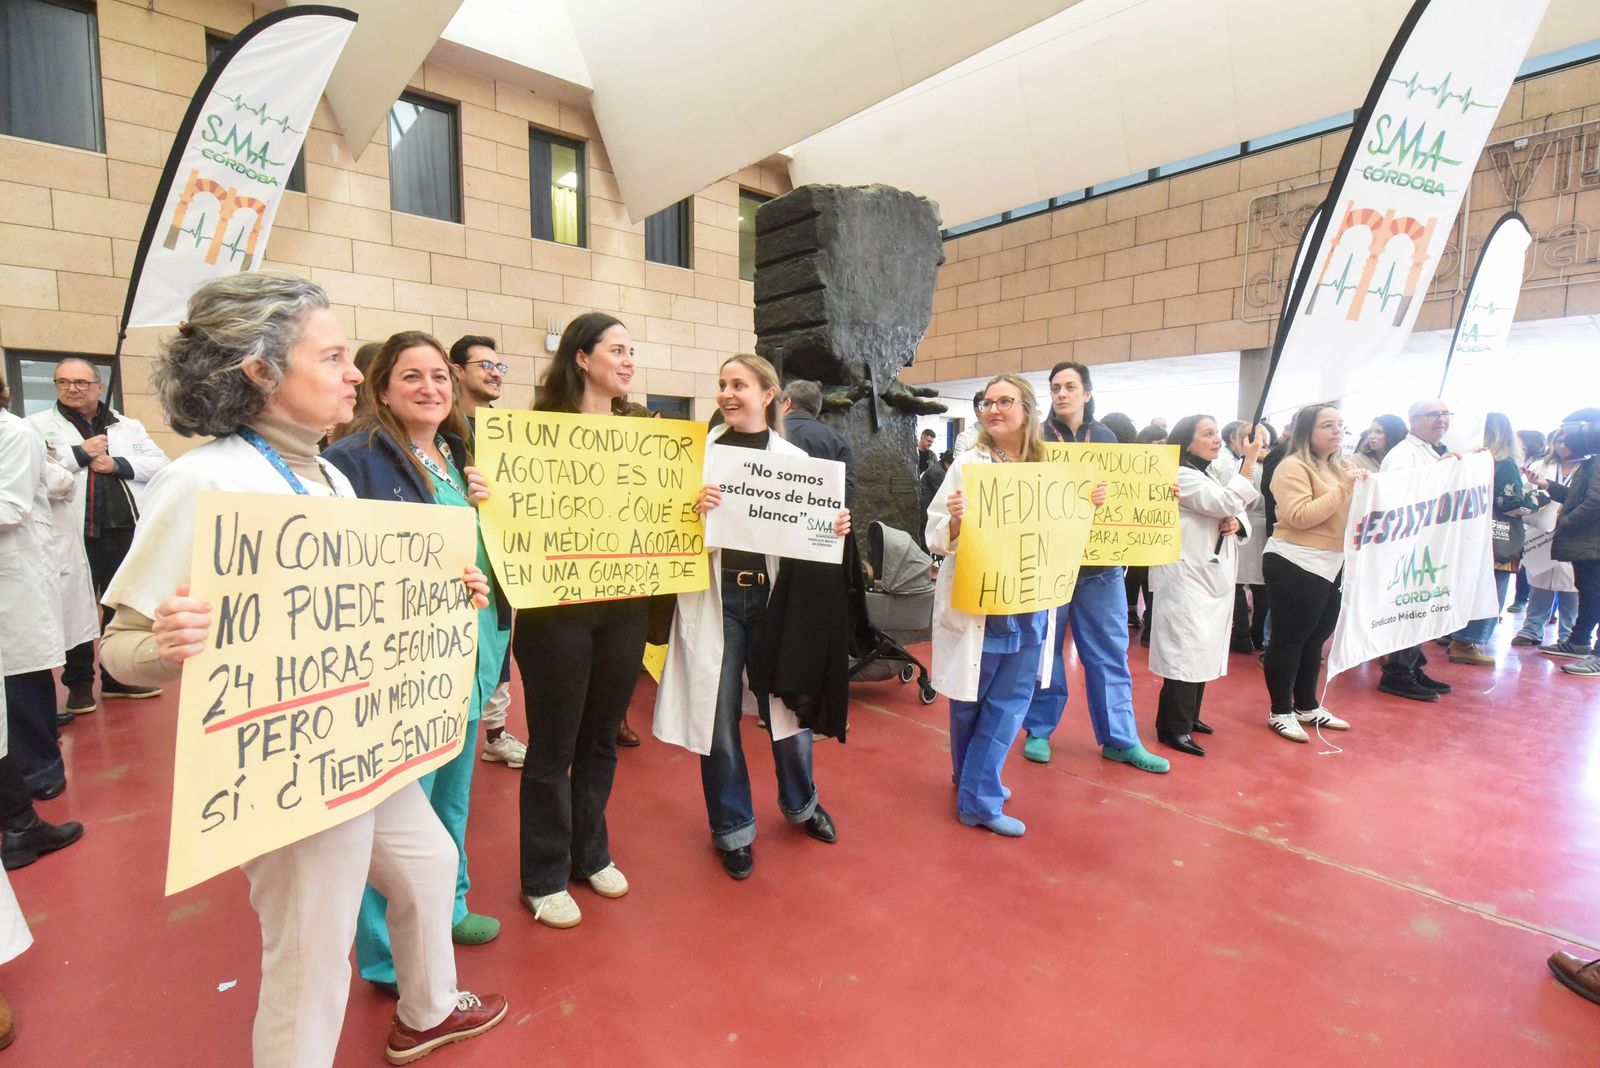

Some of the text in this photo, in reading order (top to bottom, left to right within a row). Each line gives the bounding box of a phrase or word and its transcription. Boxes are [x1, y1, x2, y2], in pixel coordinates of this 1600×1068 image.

[202, 114, 286, 170] SMA
[1367, 114, 1463, 173] SMA
[201, 148, 278, 187] CÓRDOBA
[1362, 162, 1446, 197] CÓRDOBA
[525, 422, 560, 447] UN
[569, 425, 694, 463] CONDUCTOR
[495, 452, 683, 489] AGOTADO ES UN
[776, 470, 824, 487] somos
[618, 491, 673, 523] ¿QUÉ
[680, 502, 701, 523] ES
[718, 481, 842, 510] esclavos de bata
[978, 474, 1093, 529] MÉDICOS
[807, 517, 836, 534] SMA
[1132, 506, 1177, 526] AGOTADO
[213, 511, 446, 576] UN CONDUCTOR
[503, 526, 704, 555] UN MÉDICO AGOTADO
[1019, 532, 1050, 573] EN
[1089, 530, 1174, 547] PARA SALVAR
[503, 560, 696, 585] EN UNA GUARDIA DE
[553, 581, 660, 601] 24 HORAS?
[215, 591, 261, 649] NO
[283, 581, 386, 640] PUEDE
[1371, 615, 1397, 629] Sindicato
[1398, 611, 1427, 622] Médico
[202, 621, 475, 727] 24 HORAS SEGUIDAS
[238, 671, 453, 769] PERO UN MÉDICO
[388, 696, 470, 765] SENTIDO?
